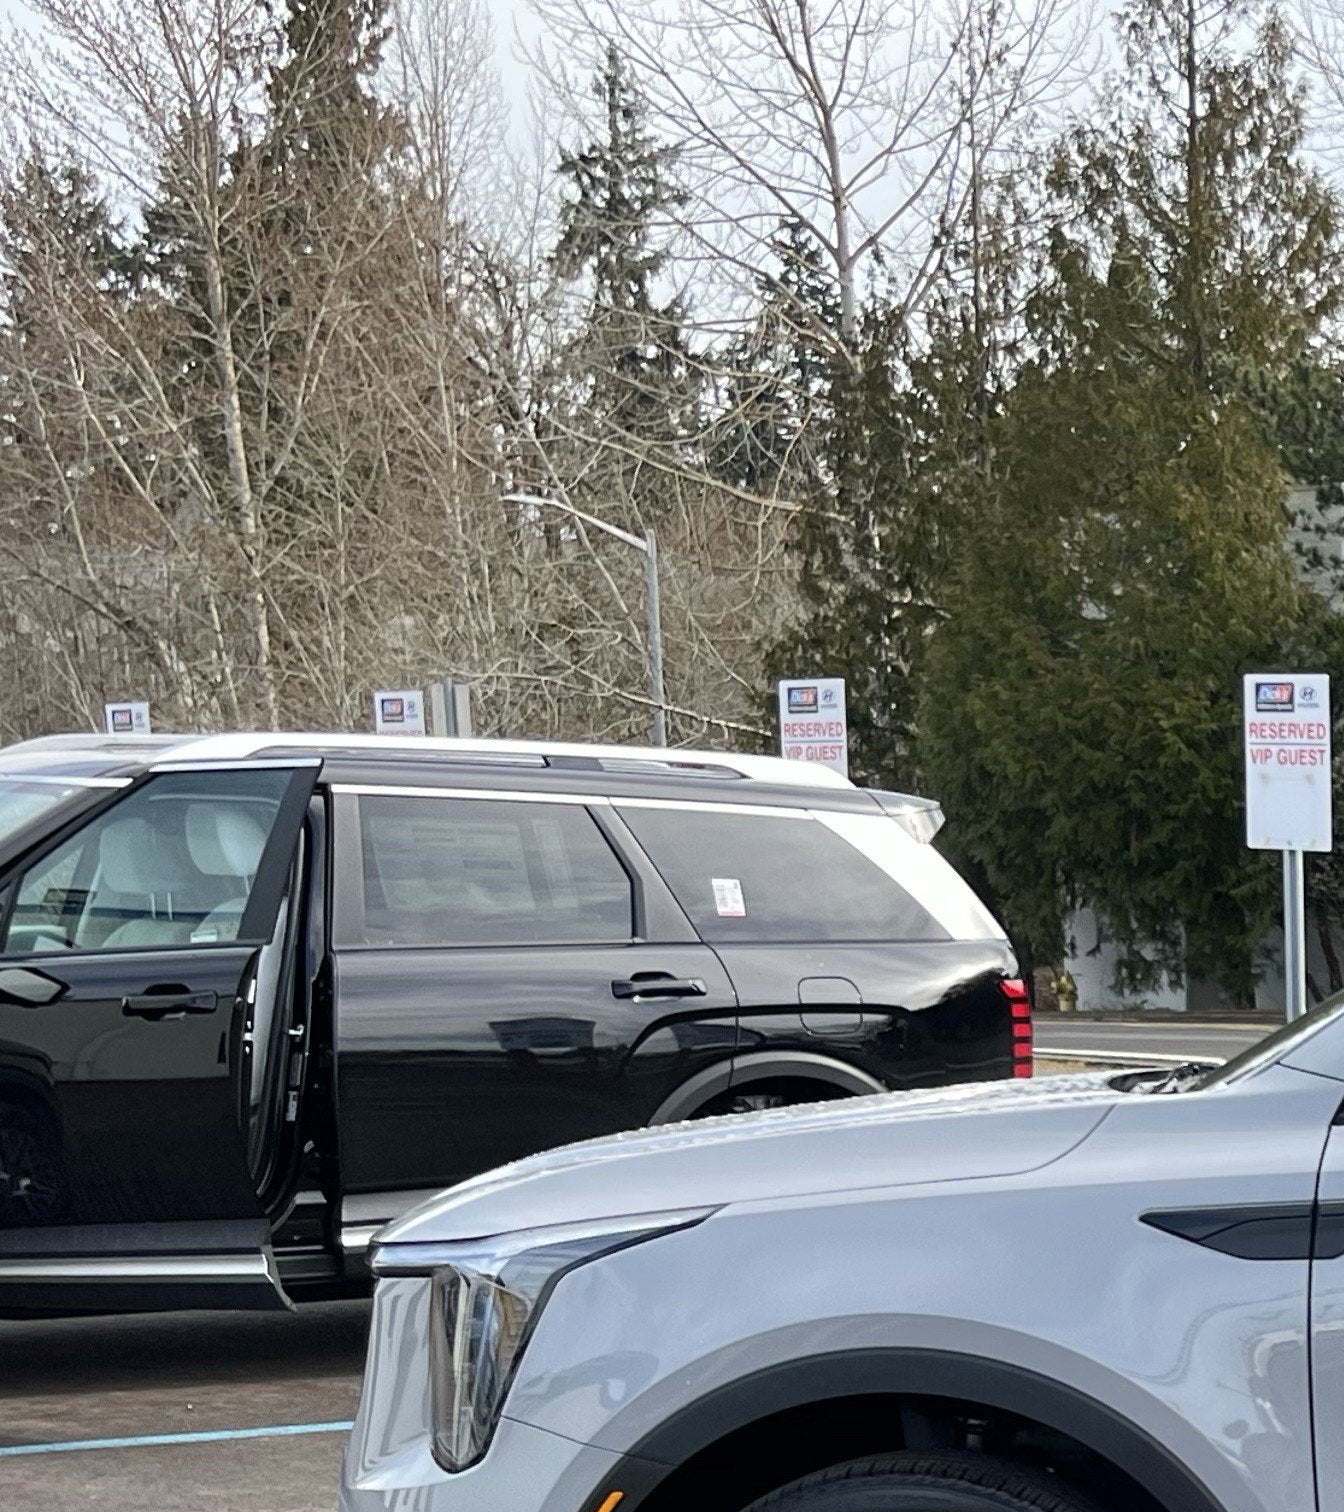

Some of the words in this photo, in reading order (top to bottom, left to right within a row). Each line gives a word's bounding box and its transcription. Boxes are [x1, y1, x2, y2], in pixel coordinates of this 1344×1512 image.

[783, 721, 843, 738] RESERVED
[1248, 722, 1326, 740] RESERVED
[1250, 748, 1273, 766] VIP
[1276, 748, 1327, 766] GUEST
